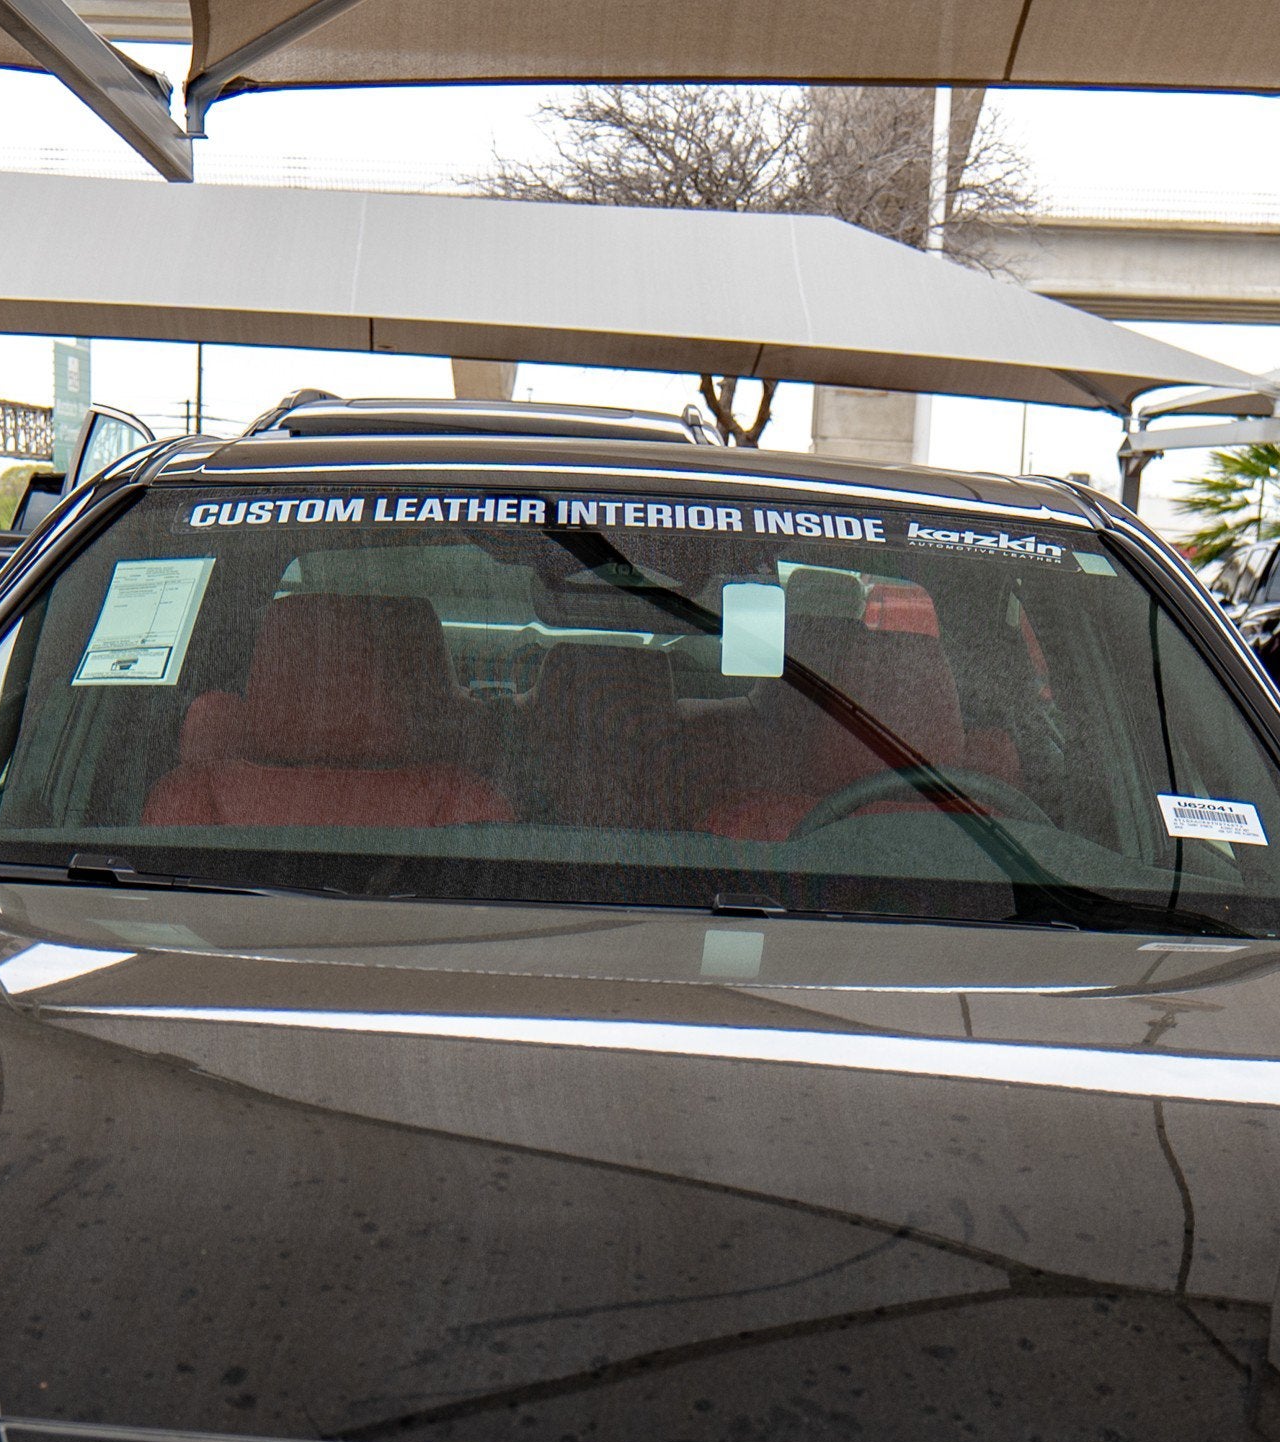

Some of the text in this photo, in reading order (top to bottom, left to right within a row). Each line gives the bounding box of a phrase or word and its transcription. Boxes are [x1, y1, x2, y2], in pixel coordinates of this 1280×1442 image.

[189, 498, 887, 544] CUSTOM LEATHER INTERIOR INSIDE
[907, 522, 1062, 557] katzkin
[908, 540, 1062, 564] AUTOMOTIVE LEATHER
[1177, 801, 1234, 813] U62041
